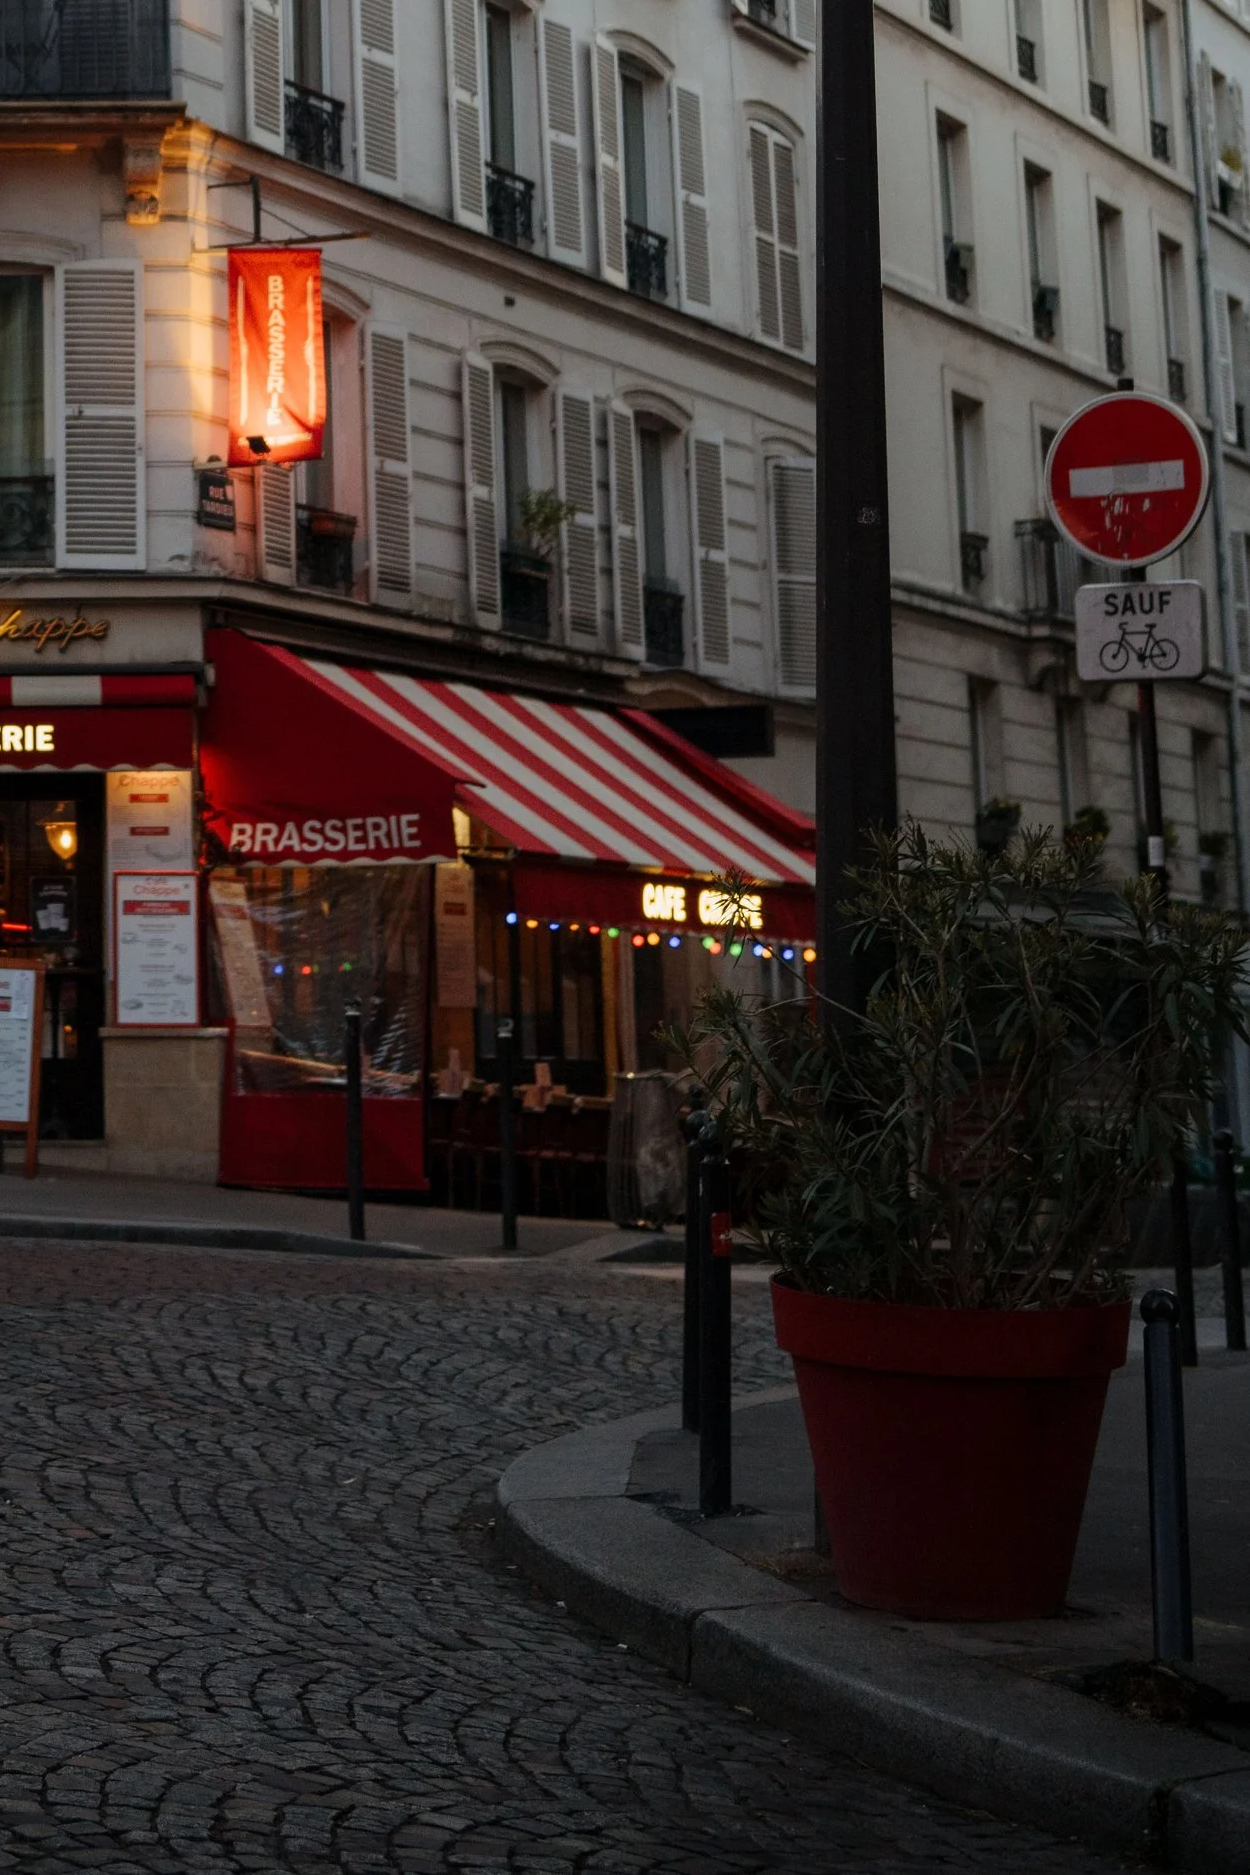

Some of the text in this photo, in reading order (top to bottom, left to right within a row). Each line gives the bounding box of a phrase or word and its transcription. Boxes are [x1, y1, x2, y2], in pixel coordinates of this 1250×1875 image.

[266, 275, 286, 426] BRASSERIE
[1104, 591, 1172, 616] SAUF
[229, 813, 422, 854] BRASSERIE
[642, 883, 687, 922] CAFE
